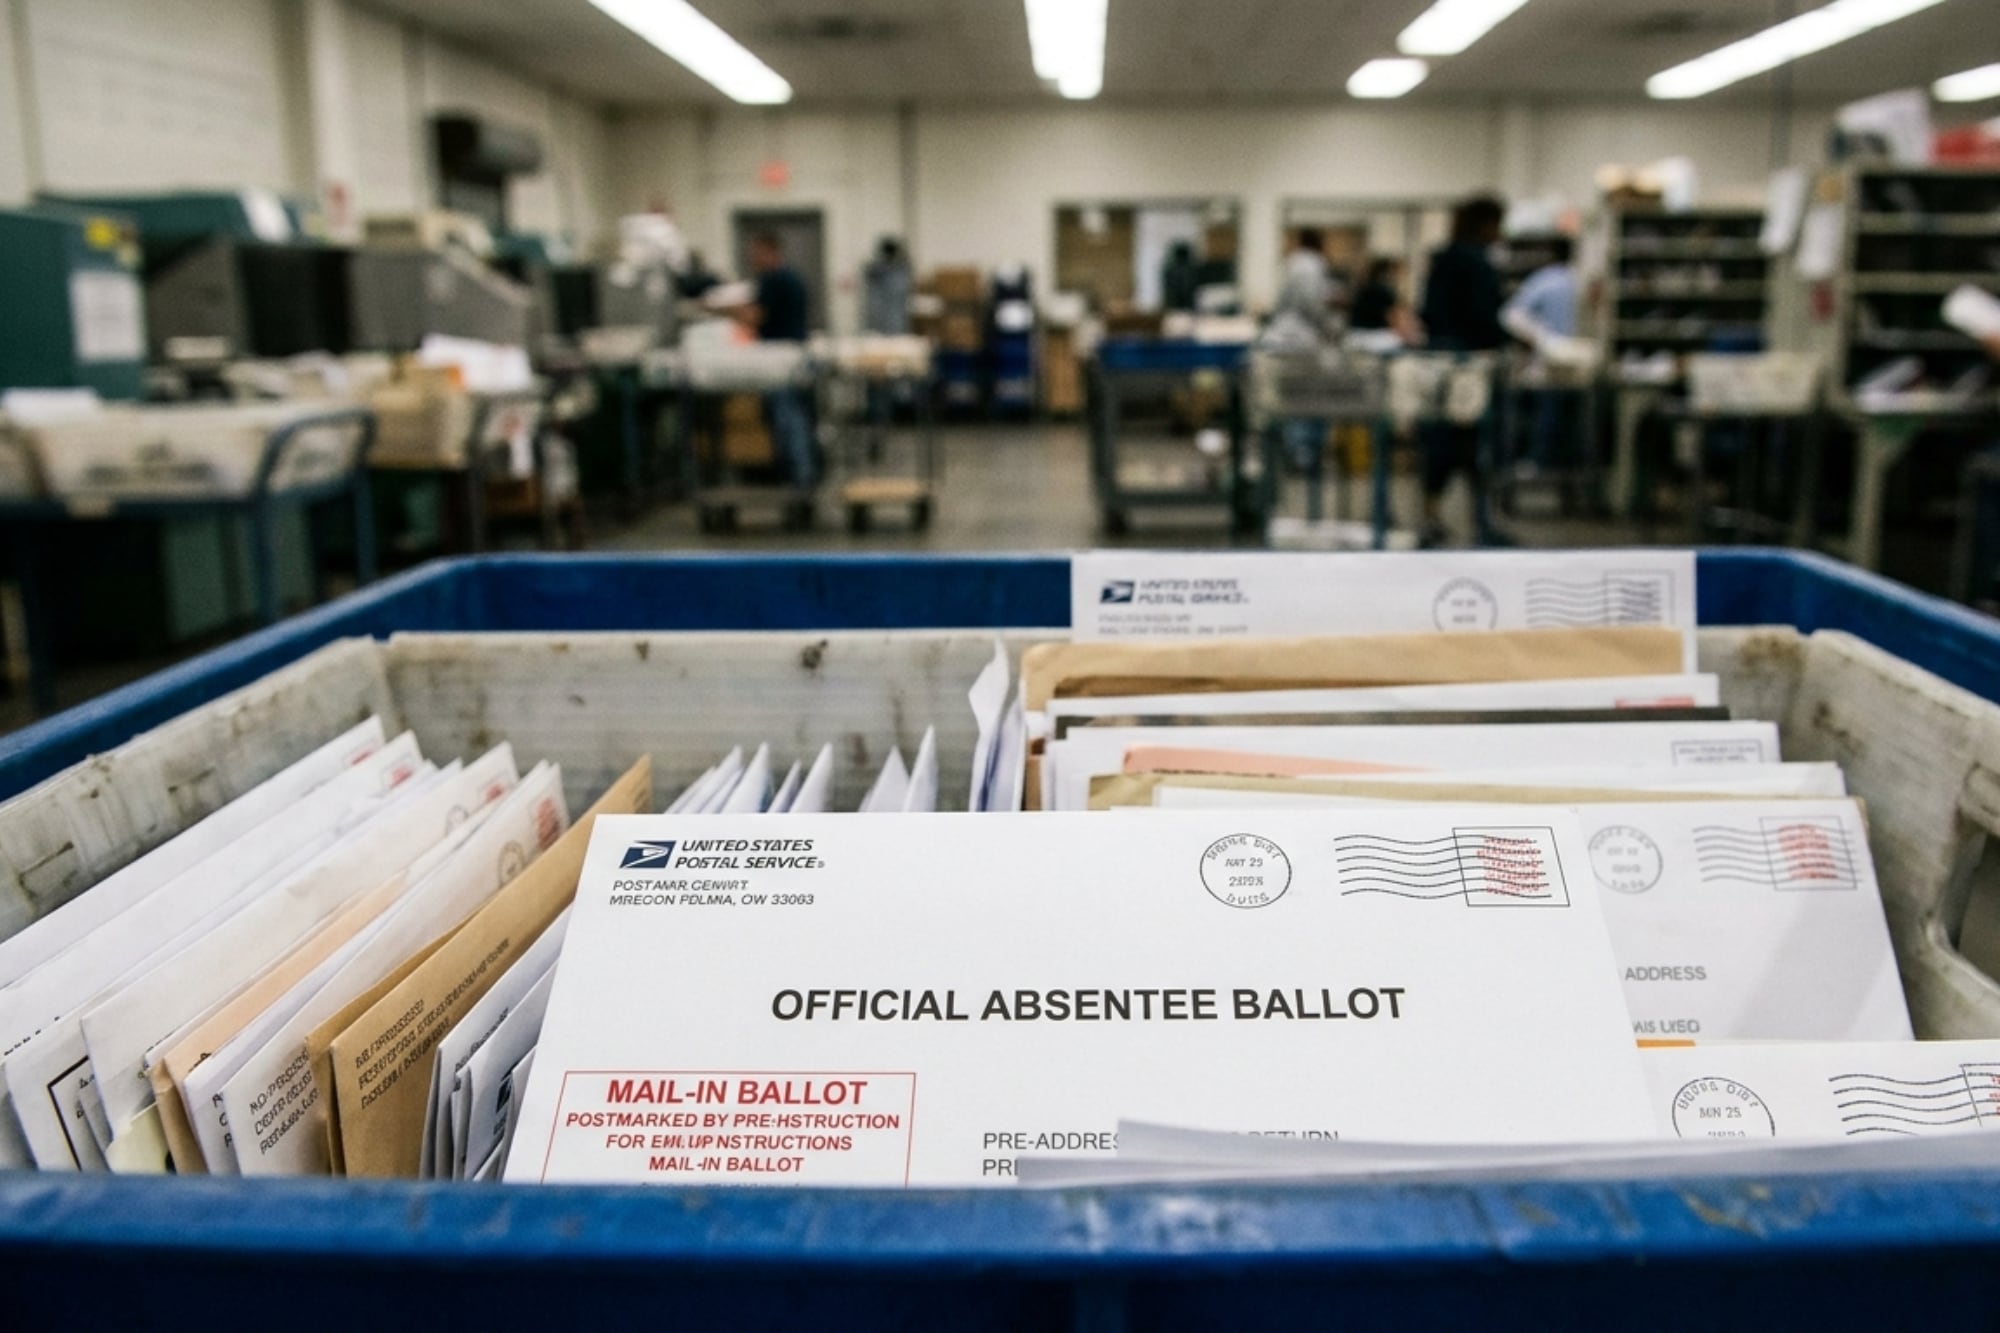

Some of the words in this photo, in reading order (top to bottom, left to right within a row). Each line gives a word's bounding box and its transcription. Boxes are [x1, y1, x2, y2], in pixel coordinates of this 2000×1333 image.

[682, 840, 748, 852] UNITED
[675, 856, 739, 869] POSTAL
[1625, 966, 1707, 981] ADDRESS
[771, 988, 970, 1022] OFFICIAL
[980, 988, 1219, 1021] ABSENTEE
[1231, 987, 1406, 1020] BALLOT
[607, 1079, 728, 1104] MAIL-IN
[737, 1080, 868, 1105] BALLOT
[566, 1112, 698, 1128] POSTMARKED
[703, 1113, 729, 1128] BY
[606, 1134, 645, 1149] FOR
[726, 1157, 804, 1173] BALLOT
